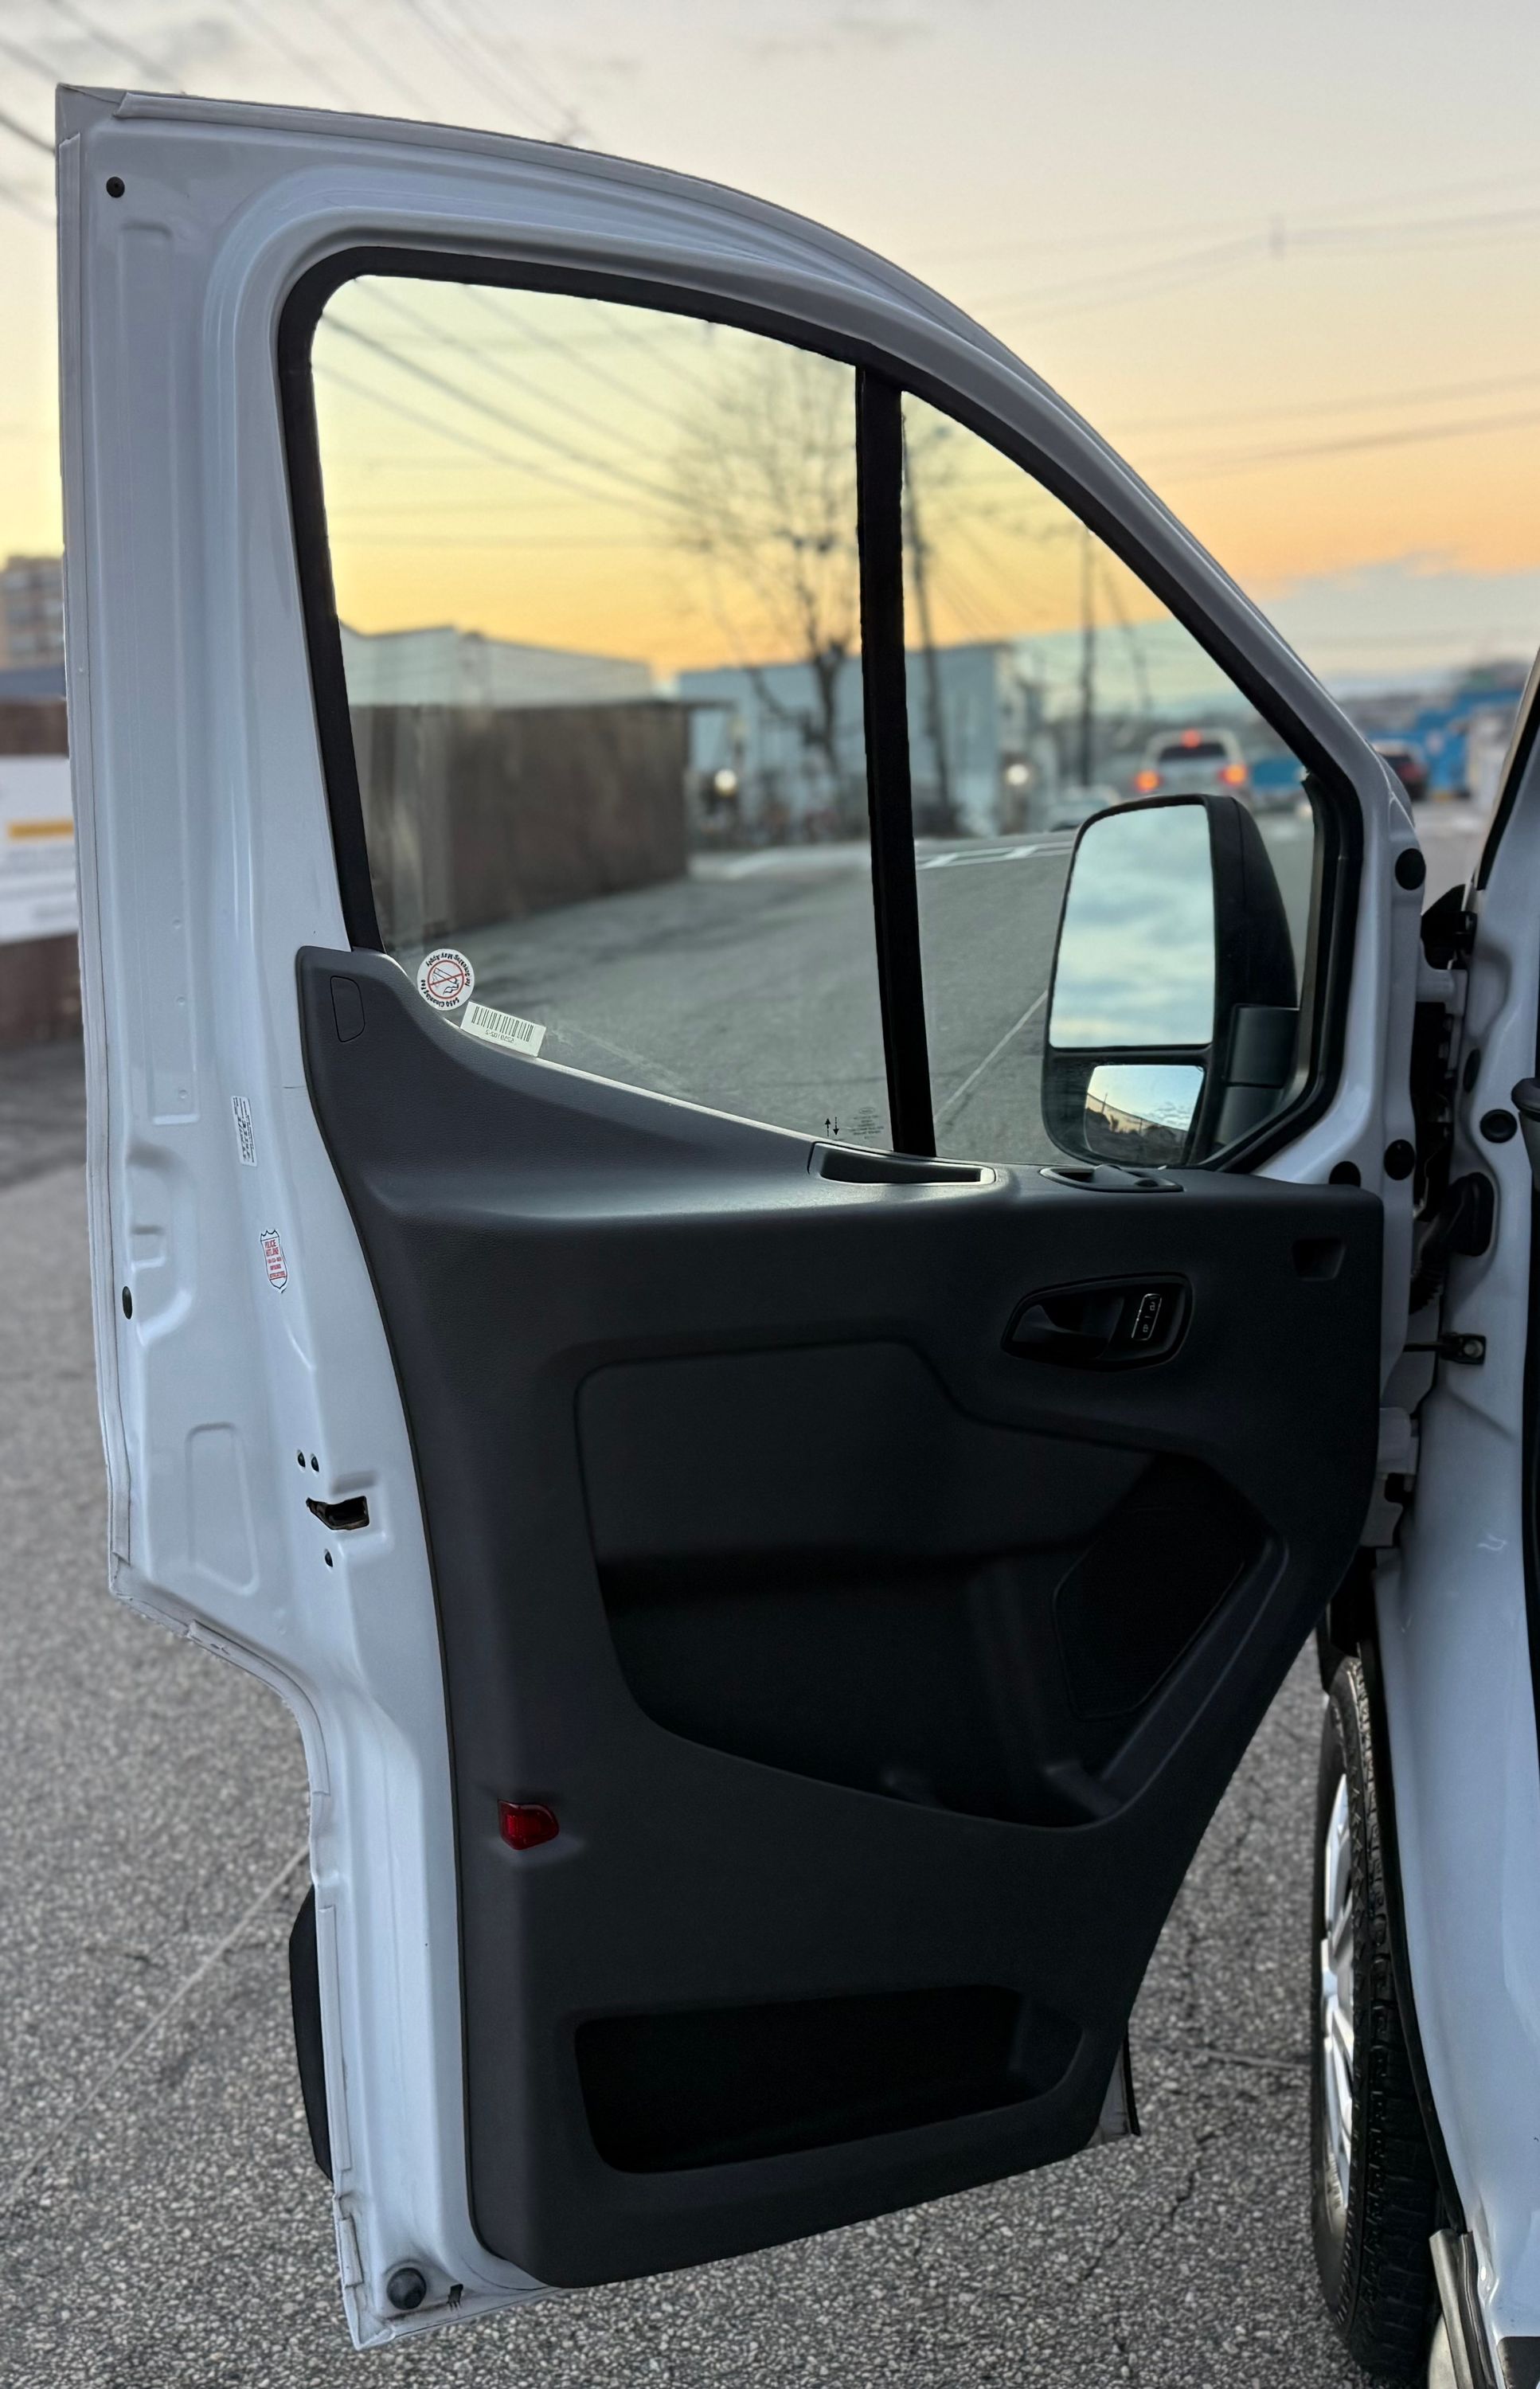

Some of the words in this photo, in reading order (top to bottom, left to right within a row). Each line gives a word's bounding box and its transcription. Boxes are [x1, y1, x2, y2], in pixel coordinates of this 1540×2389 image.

[425, 955, 440, 967] Apply
[454, 954, 471, 977] Smoking
[424, 990, 445, 1007] Cleaning
